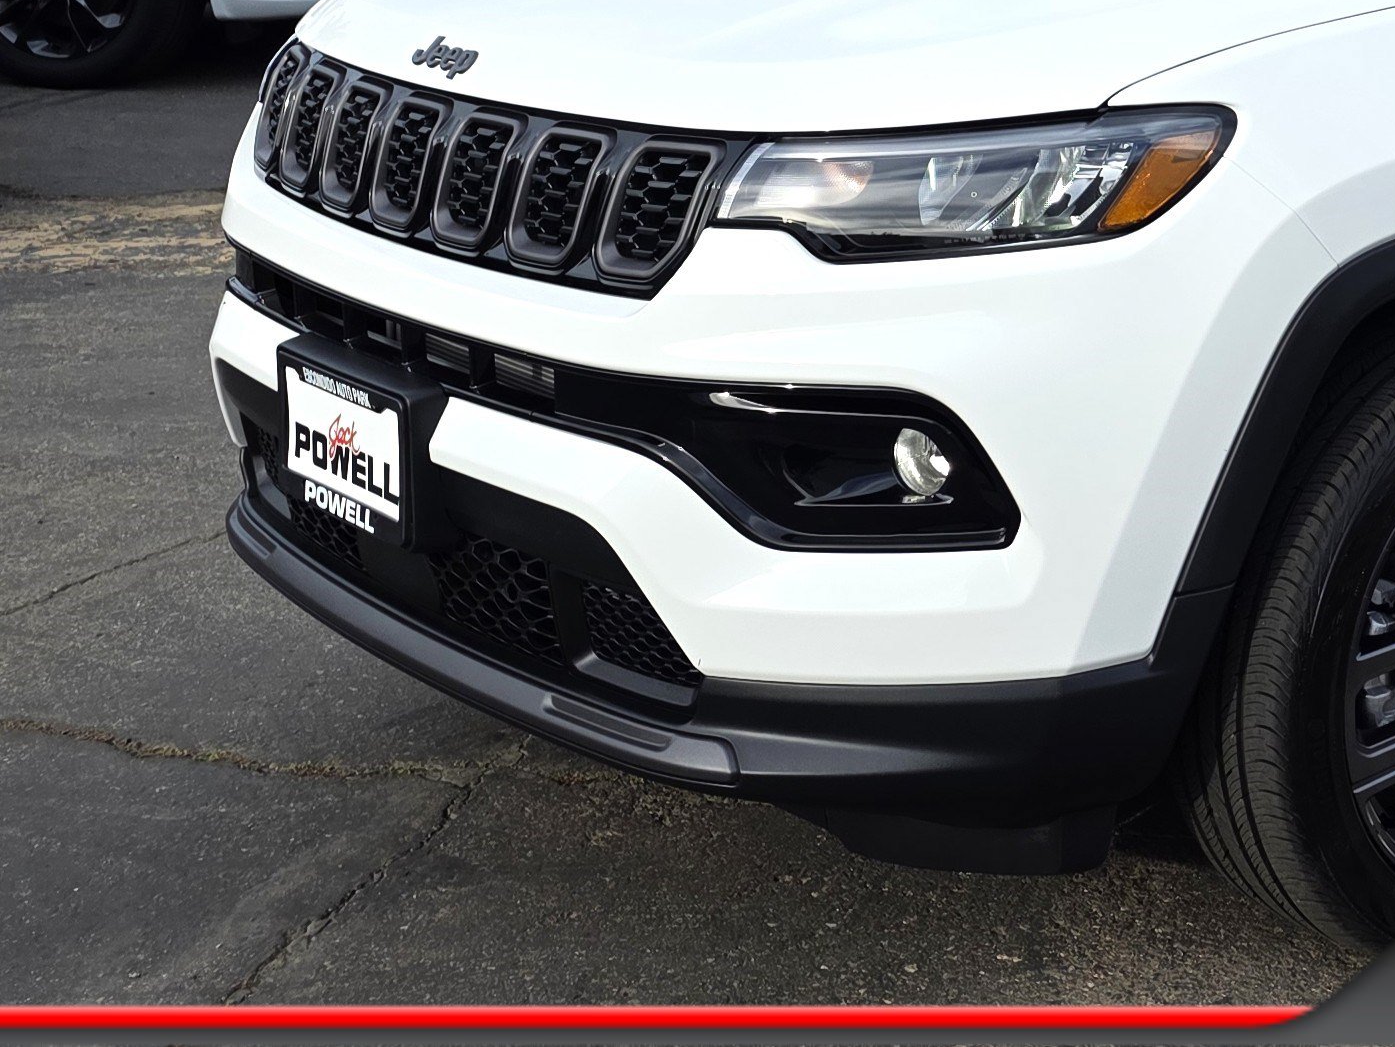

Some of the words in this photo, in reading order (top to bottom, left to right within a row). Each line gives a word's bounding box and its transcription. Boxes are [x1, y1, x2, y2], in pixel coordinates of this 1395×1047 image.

[411, 35, 479, 81] Jeep
[302, 366, 337, 395] ESCONDIDO
[335, 380, 354, 402] AUTO
[352, 387, 372, 409] PARK
[328, 413, 361, 459] Jack
[295, 421, 400, 507] POWELL
[304, 479, 375, 534] POWELL
